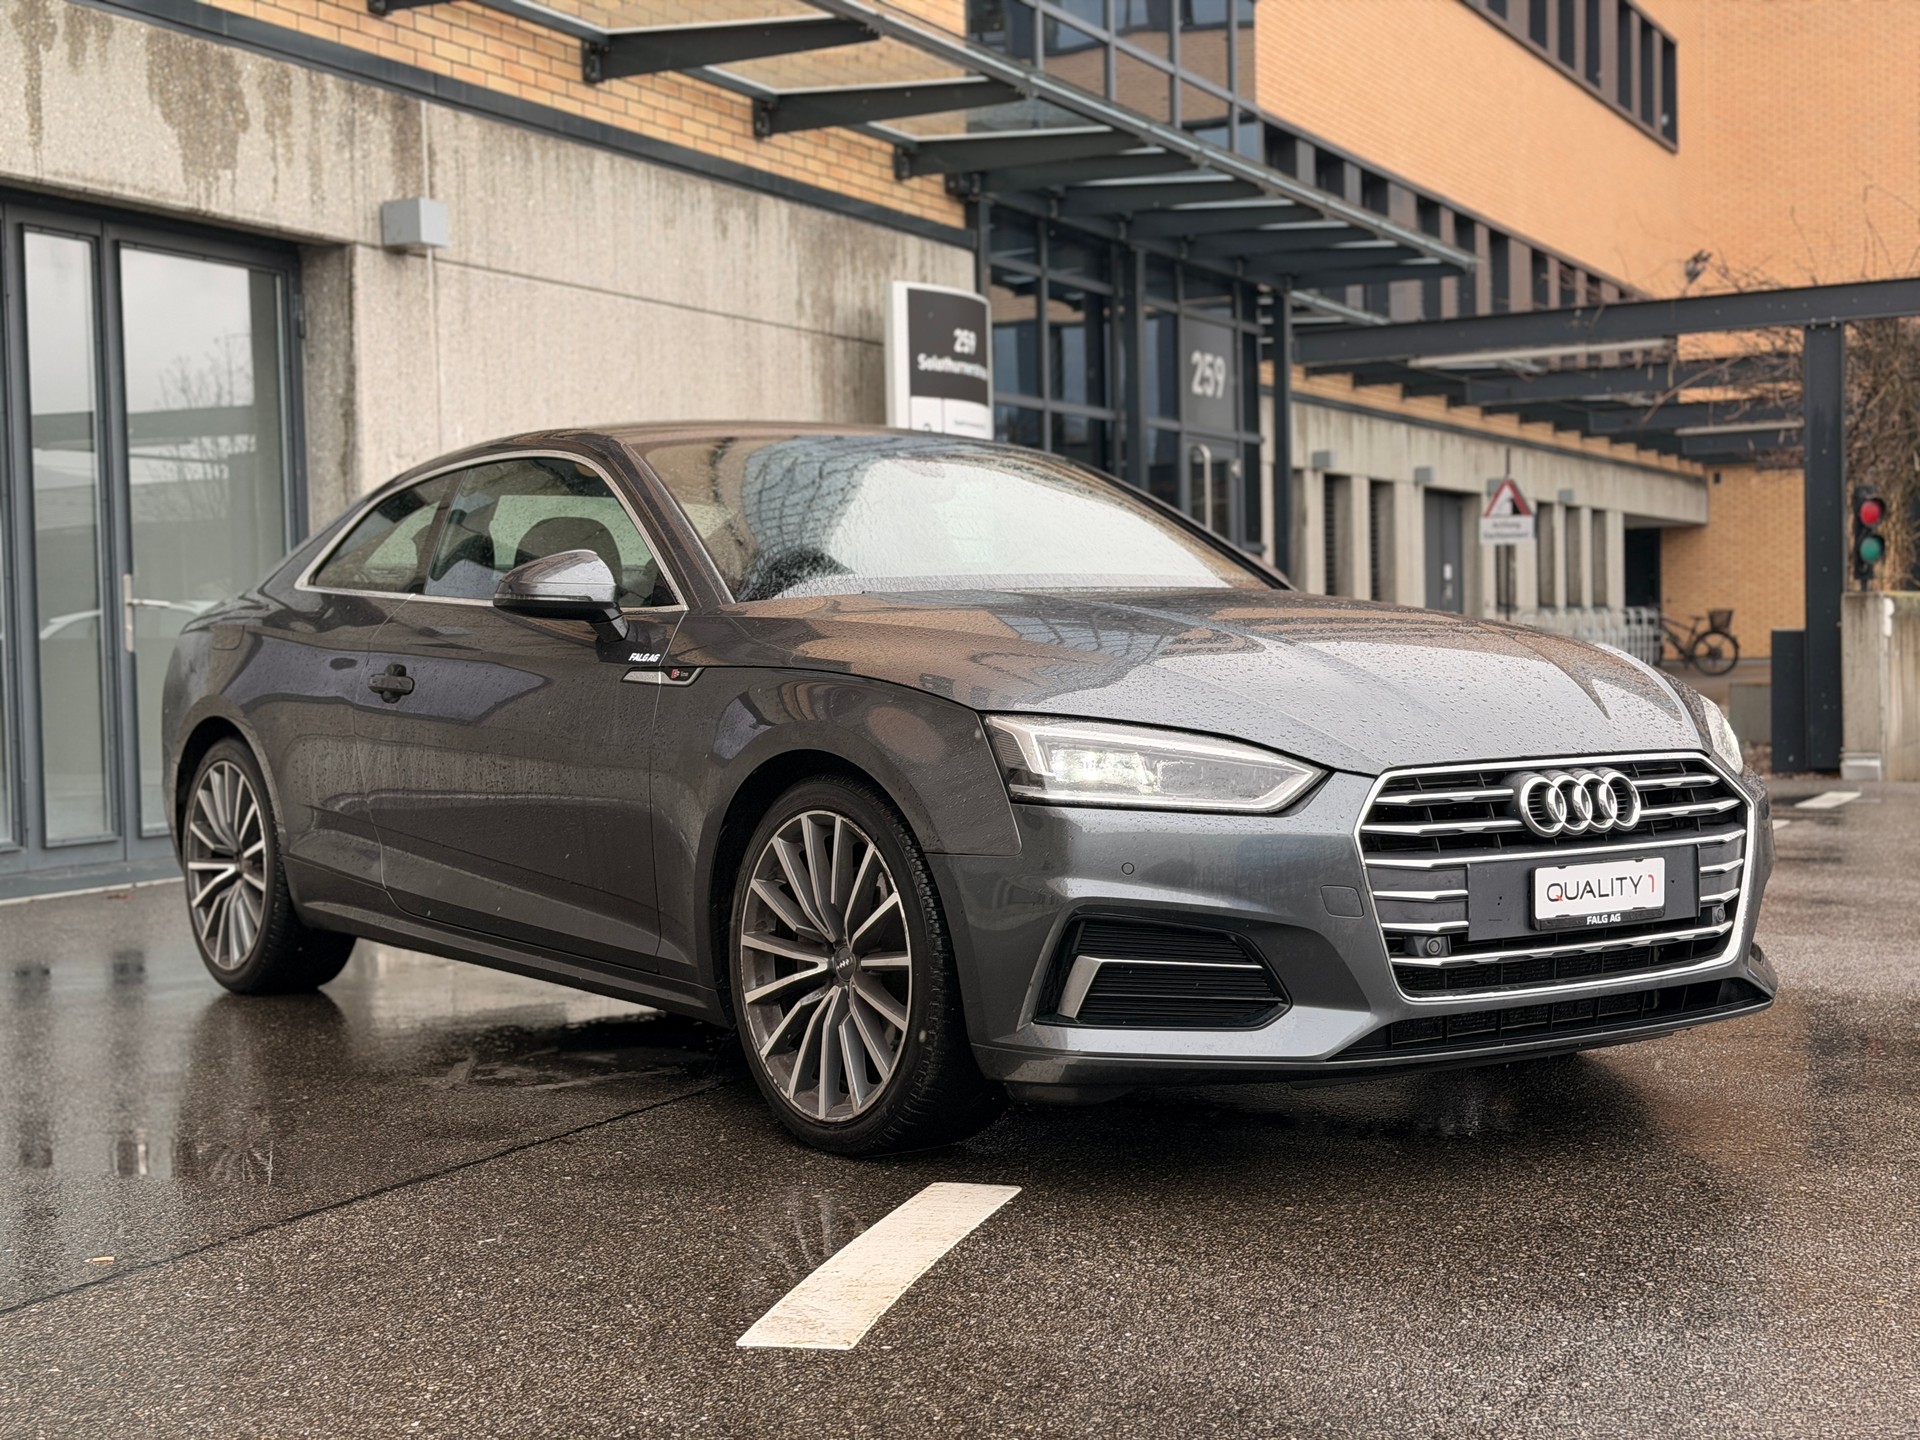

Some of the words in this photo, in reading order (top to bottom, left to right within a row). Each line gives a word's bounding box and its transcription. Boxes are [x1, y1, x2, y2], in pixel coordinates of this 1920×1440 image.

[953, 328, 977, 355] 259
[1191, 350, 1226, 399] 259
[628, 652, 649, 662] FALG
[647, 653, 660, 662] AG
[1546, 874, 1643, 903] QUALITY
[1647, 873, 1655, 893] 1
[1586, 914, 1608, 925] FALG
[1609, 913, 1621, 923] AG
